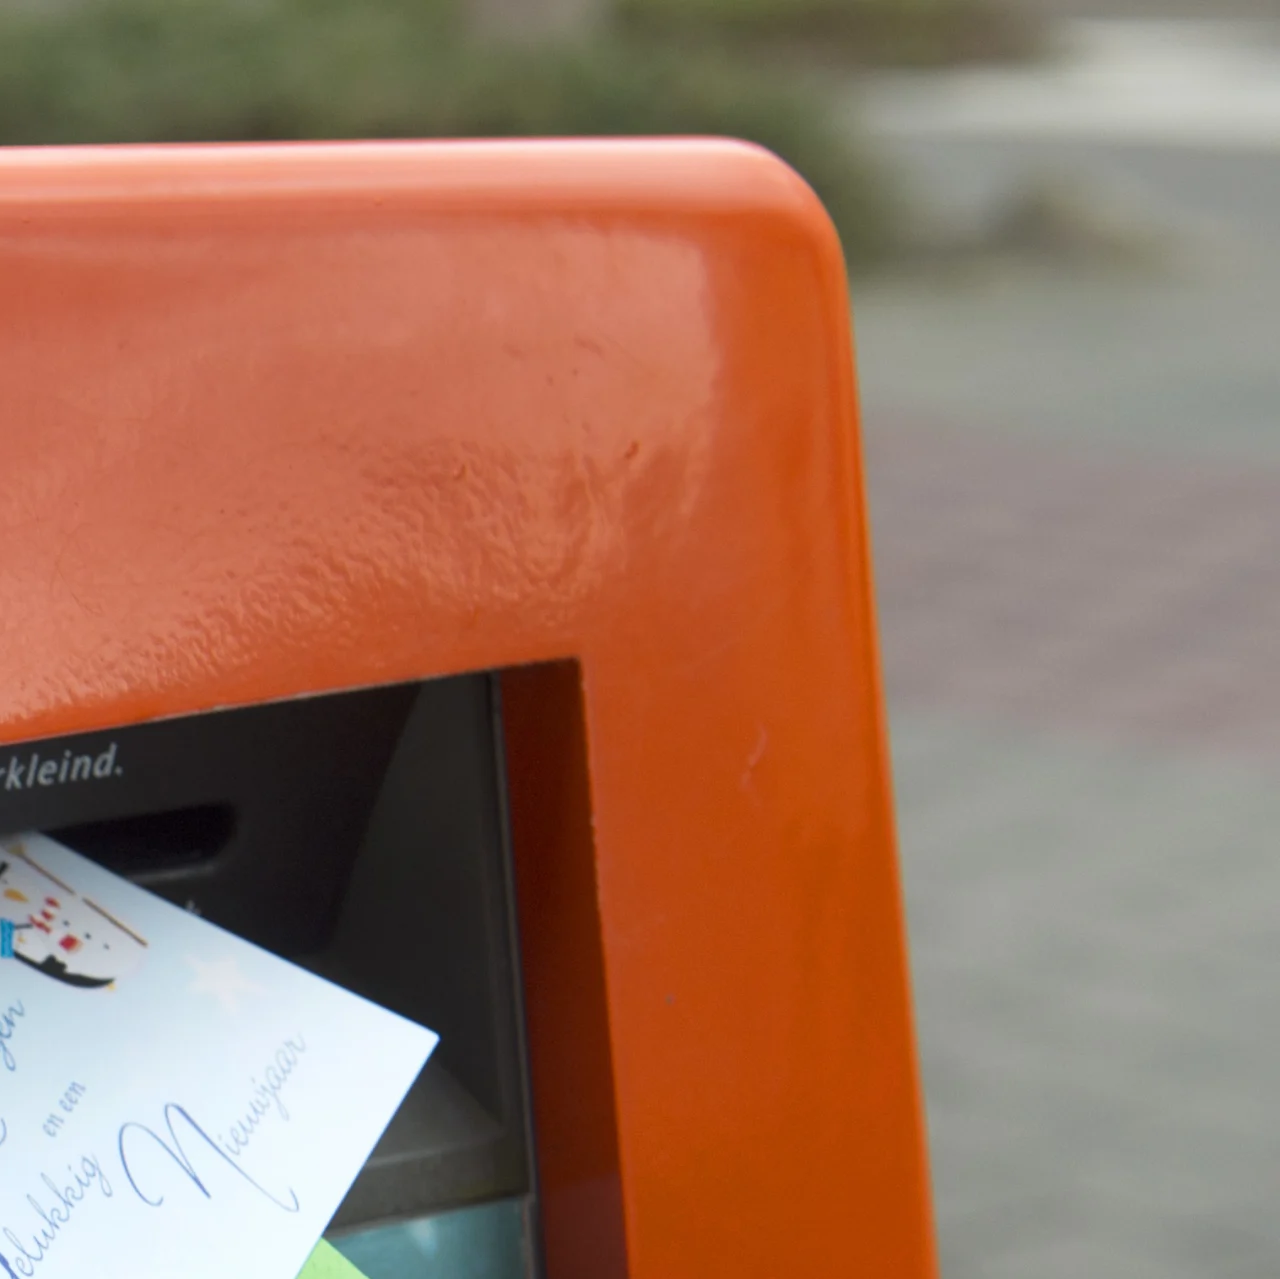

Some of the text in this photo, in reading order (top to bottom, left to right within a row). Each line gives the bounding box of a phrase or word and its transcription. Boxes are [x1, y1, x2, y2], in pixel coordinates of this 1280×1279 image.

[42, 1080, 87, 1139] en een
[118, 1031, 308, 1213] Nieuwjaar
